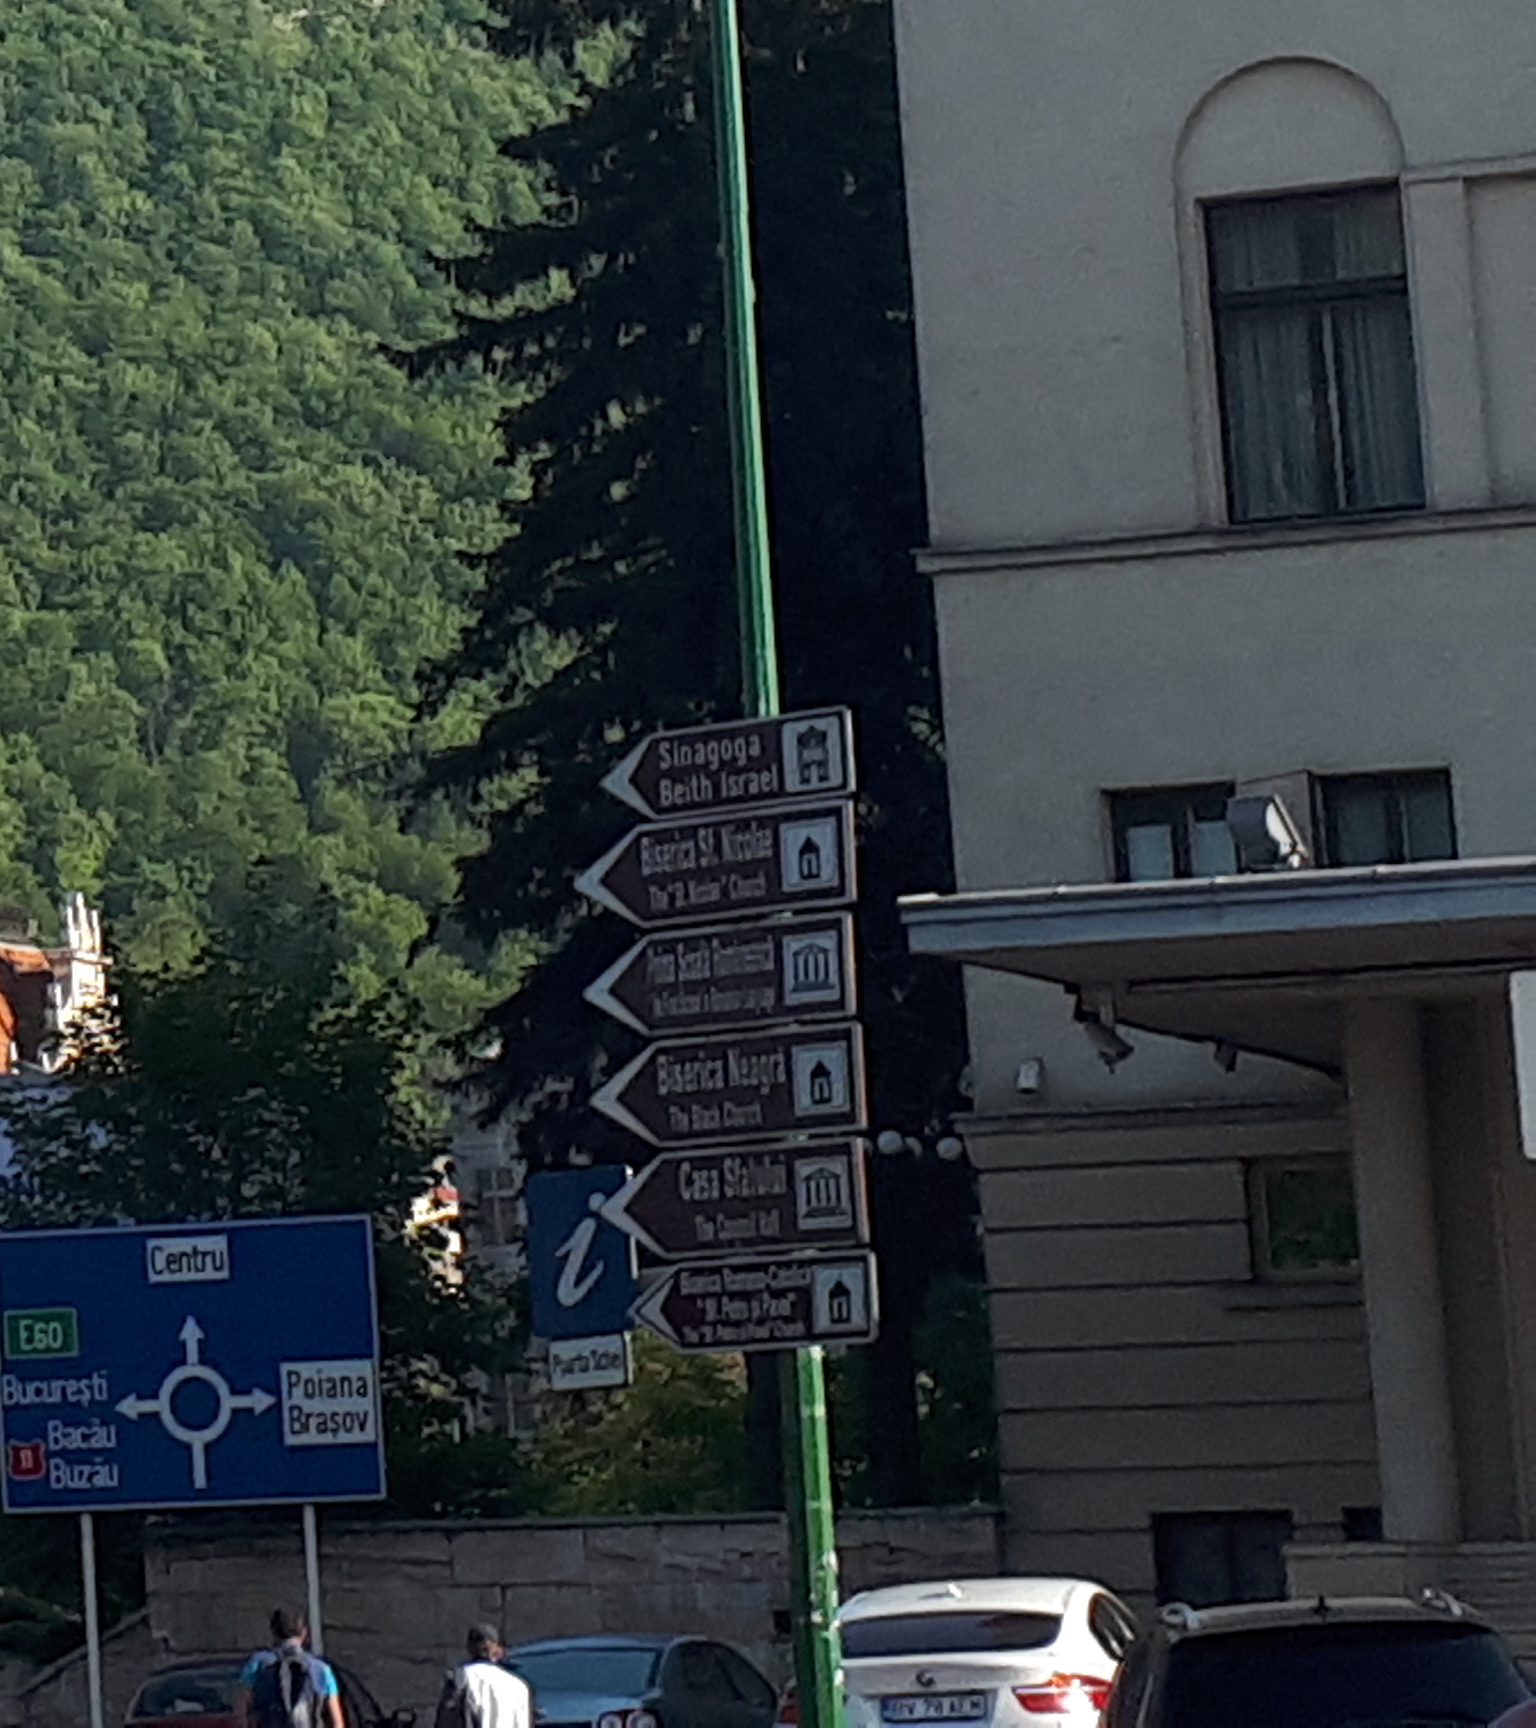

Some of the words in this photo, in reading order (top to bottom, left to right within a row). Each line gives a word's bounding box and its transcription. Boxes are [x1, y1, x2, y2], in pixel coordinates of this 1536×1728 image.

[658, 734, 762, 770] Sinagoga
[659, 773, 714, 806] Beith
[720, 763, 778, 798] Israel
[149, 1244, 226, 1275] Centru
[18, 1319, 64, 1351] E60
[286, 1368, 368, 1401] Poiana
[47, 1417, 117, 1451] Bacău
[49, 1456, 119, 1489] Buzău
